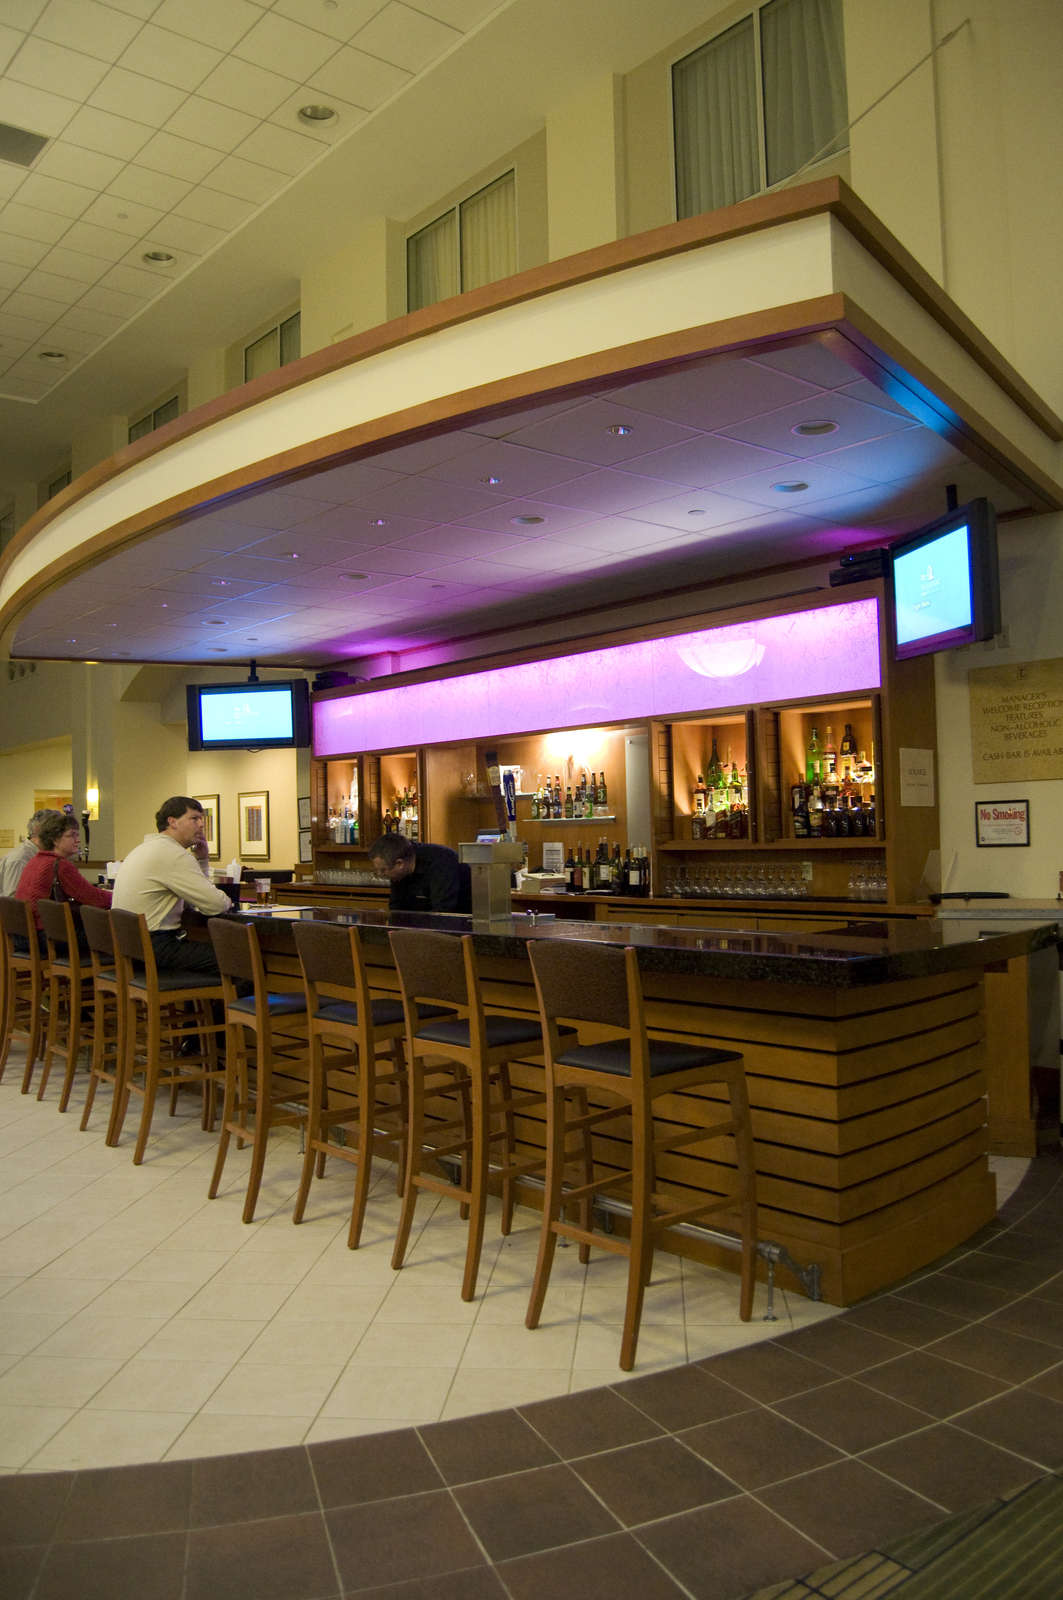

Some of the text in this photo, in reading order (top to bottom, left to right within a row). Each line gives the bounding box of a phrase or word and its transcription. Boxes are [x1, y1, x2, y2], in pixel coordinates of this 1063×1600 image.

[982, 703, 1020, 714] WELCOME
[1006, 711, 1044, 722] FEATURES
[991, 719, 1061, 732] NON-ALCOHOLIC
[982, 751, 1004, 761] CASH
[1007, 750, 1022, 759] BAR
[980, 807, 1026, 822] No Smoking
